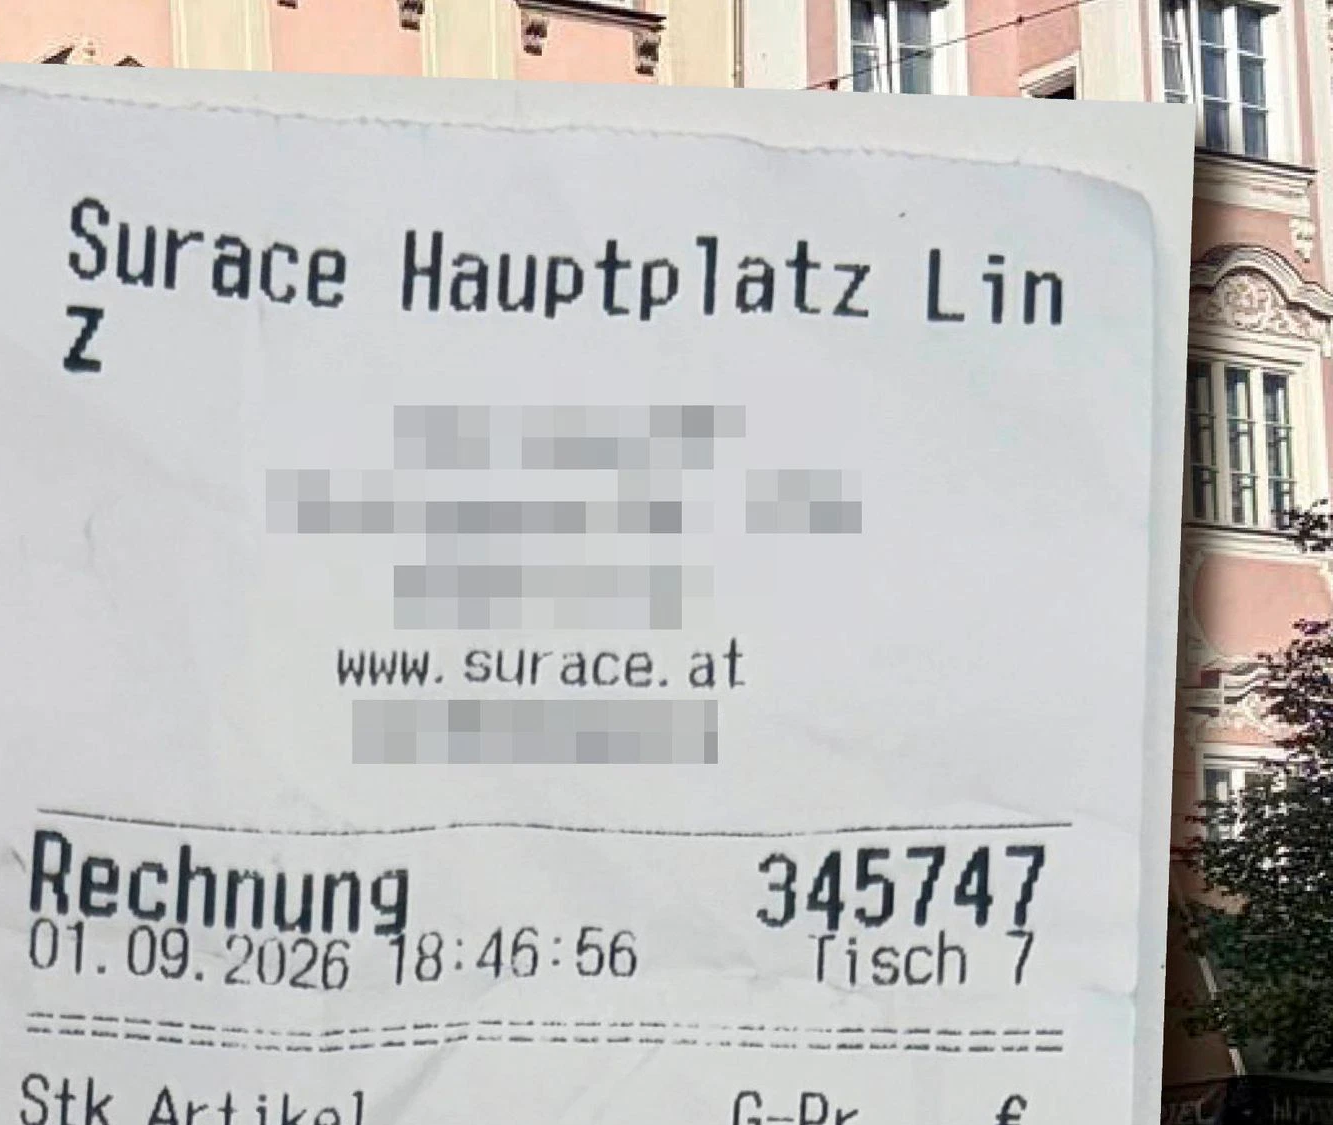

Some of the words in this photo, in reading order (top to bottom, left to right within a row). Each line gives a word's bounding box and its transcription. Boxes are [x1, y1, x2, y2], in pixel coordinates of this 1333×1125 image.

[68, 197, 347, 309] Surace
[401, 228, 871, 321] Hauptplatz
[926, 248, 1063, 325] Lin
[336, 637, 746, 688] www.surace.at
[30, 831, 409, 936] Rechnung
[757, 845, 1045, 931] 345747
[30, 919, 349, 990] 01.09.2026
[390, 928, 638, 985] 18:46:56
[807, 932, 967, 986] Tisch
[1005, 931, 1035, 984] 7
